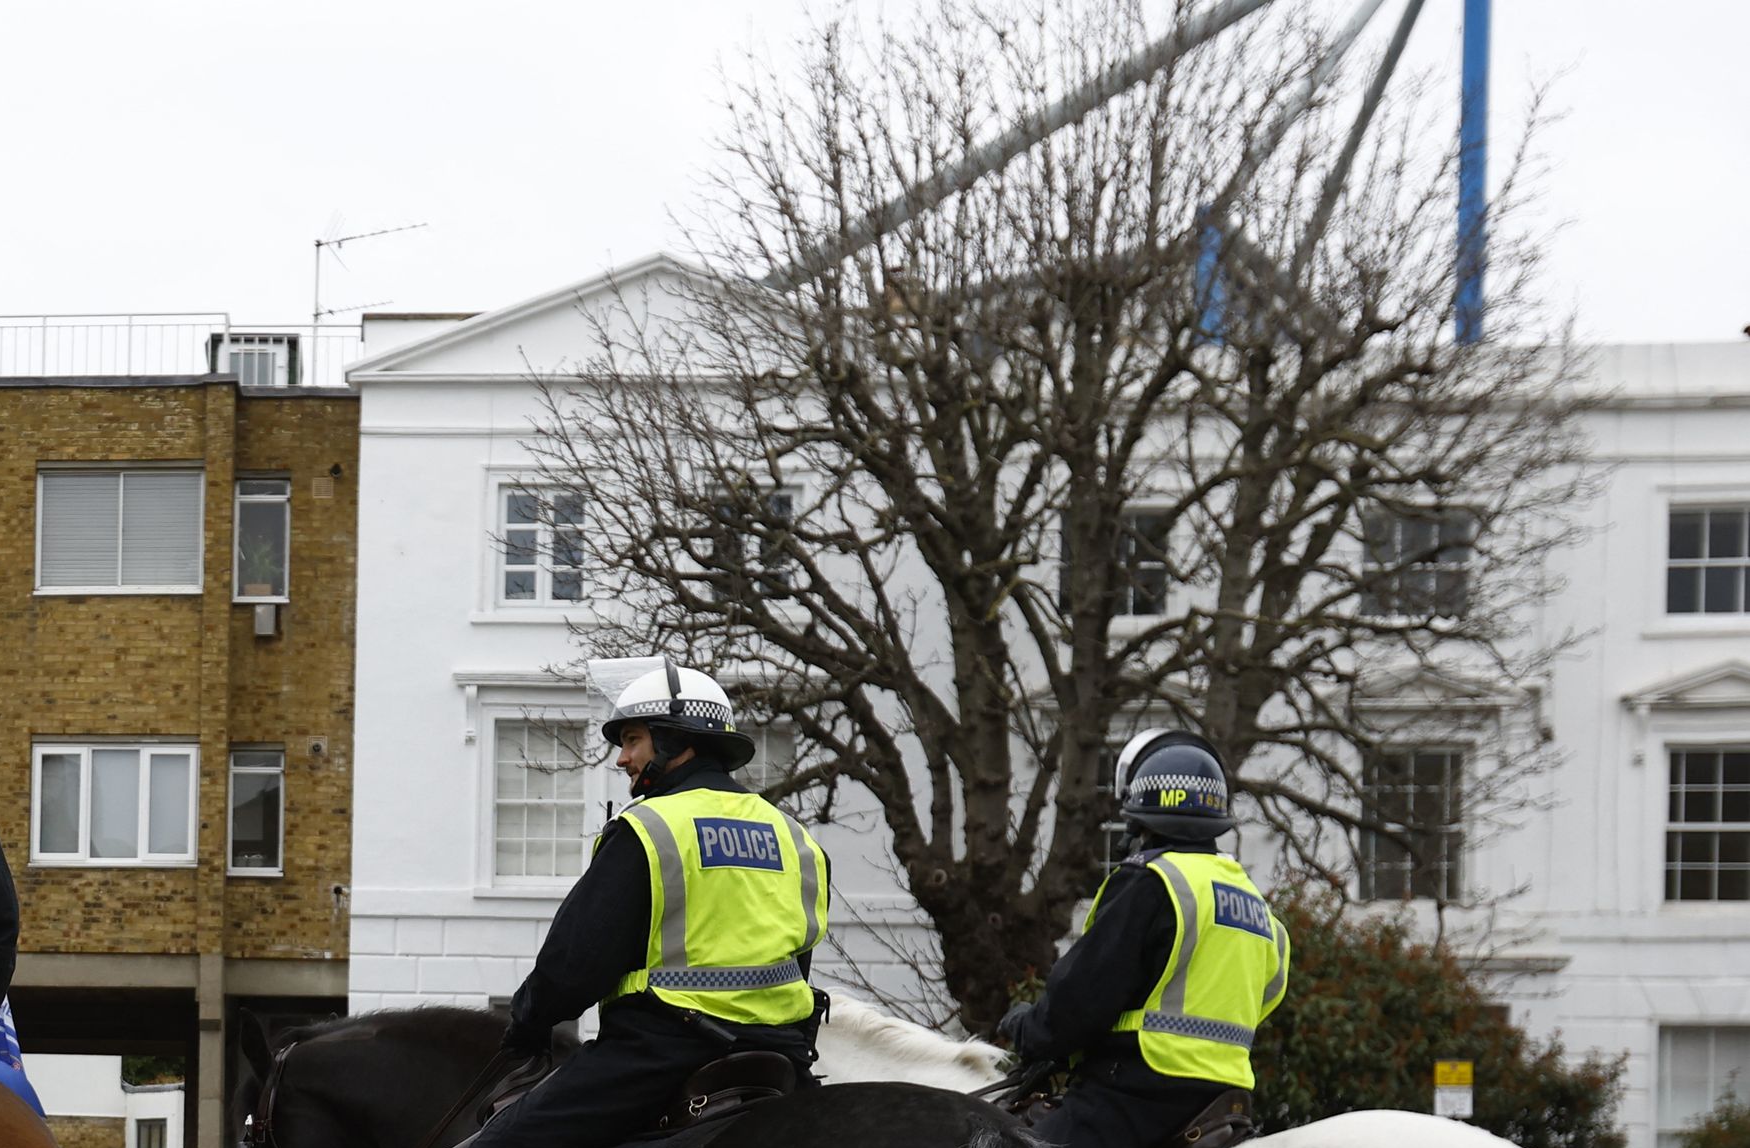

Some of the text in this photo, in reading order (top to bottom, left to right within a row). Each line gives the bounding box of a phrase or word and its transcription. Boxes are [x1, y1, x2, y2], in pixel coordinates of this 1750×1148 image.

[1160, 789, 1187, 808] MP
[702, 826, 778, 862] POLICE
[1216, 888, 1271, 933] POLICE
